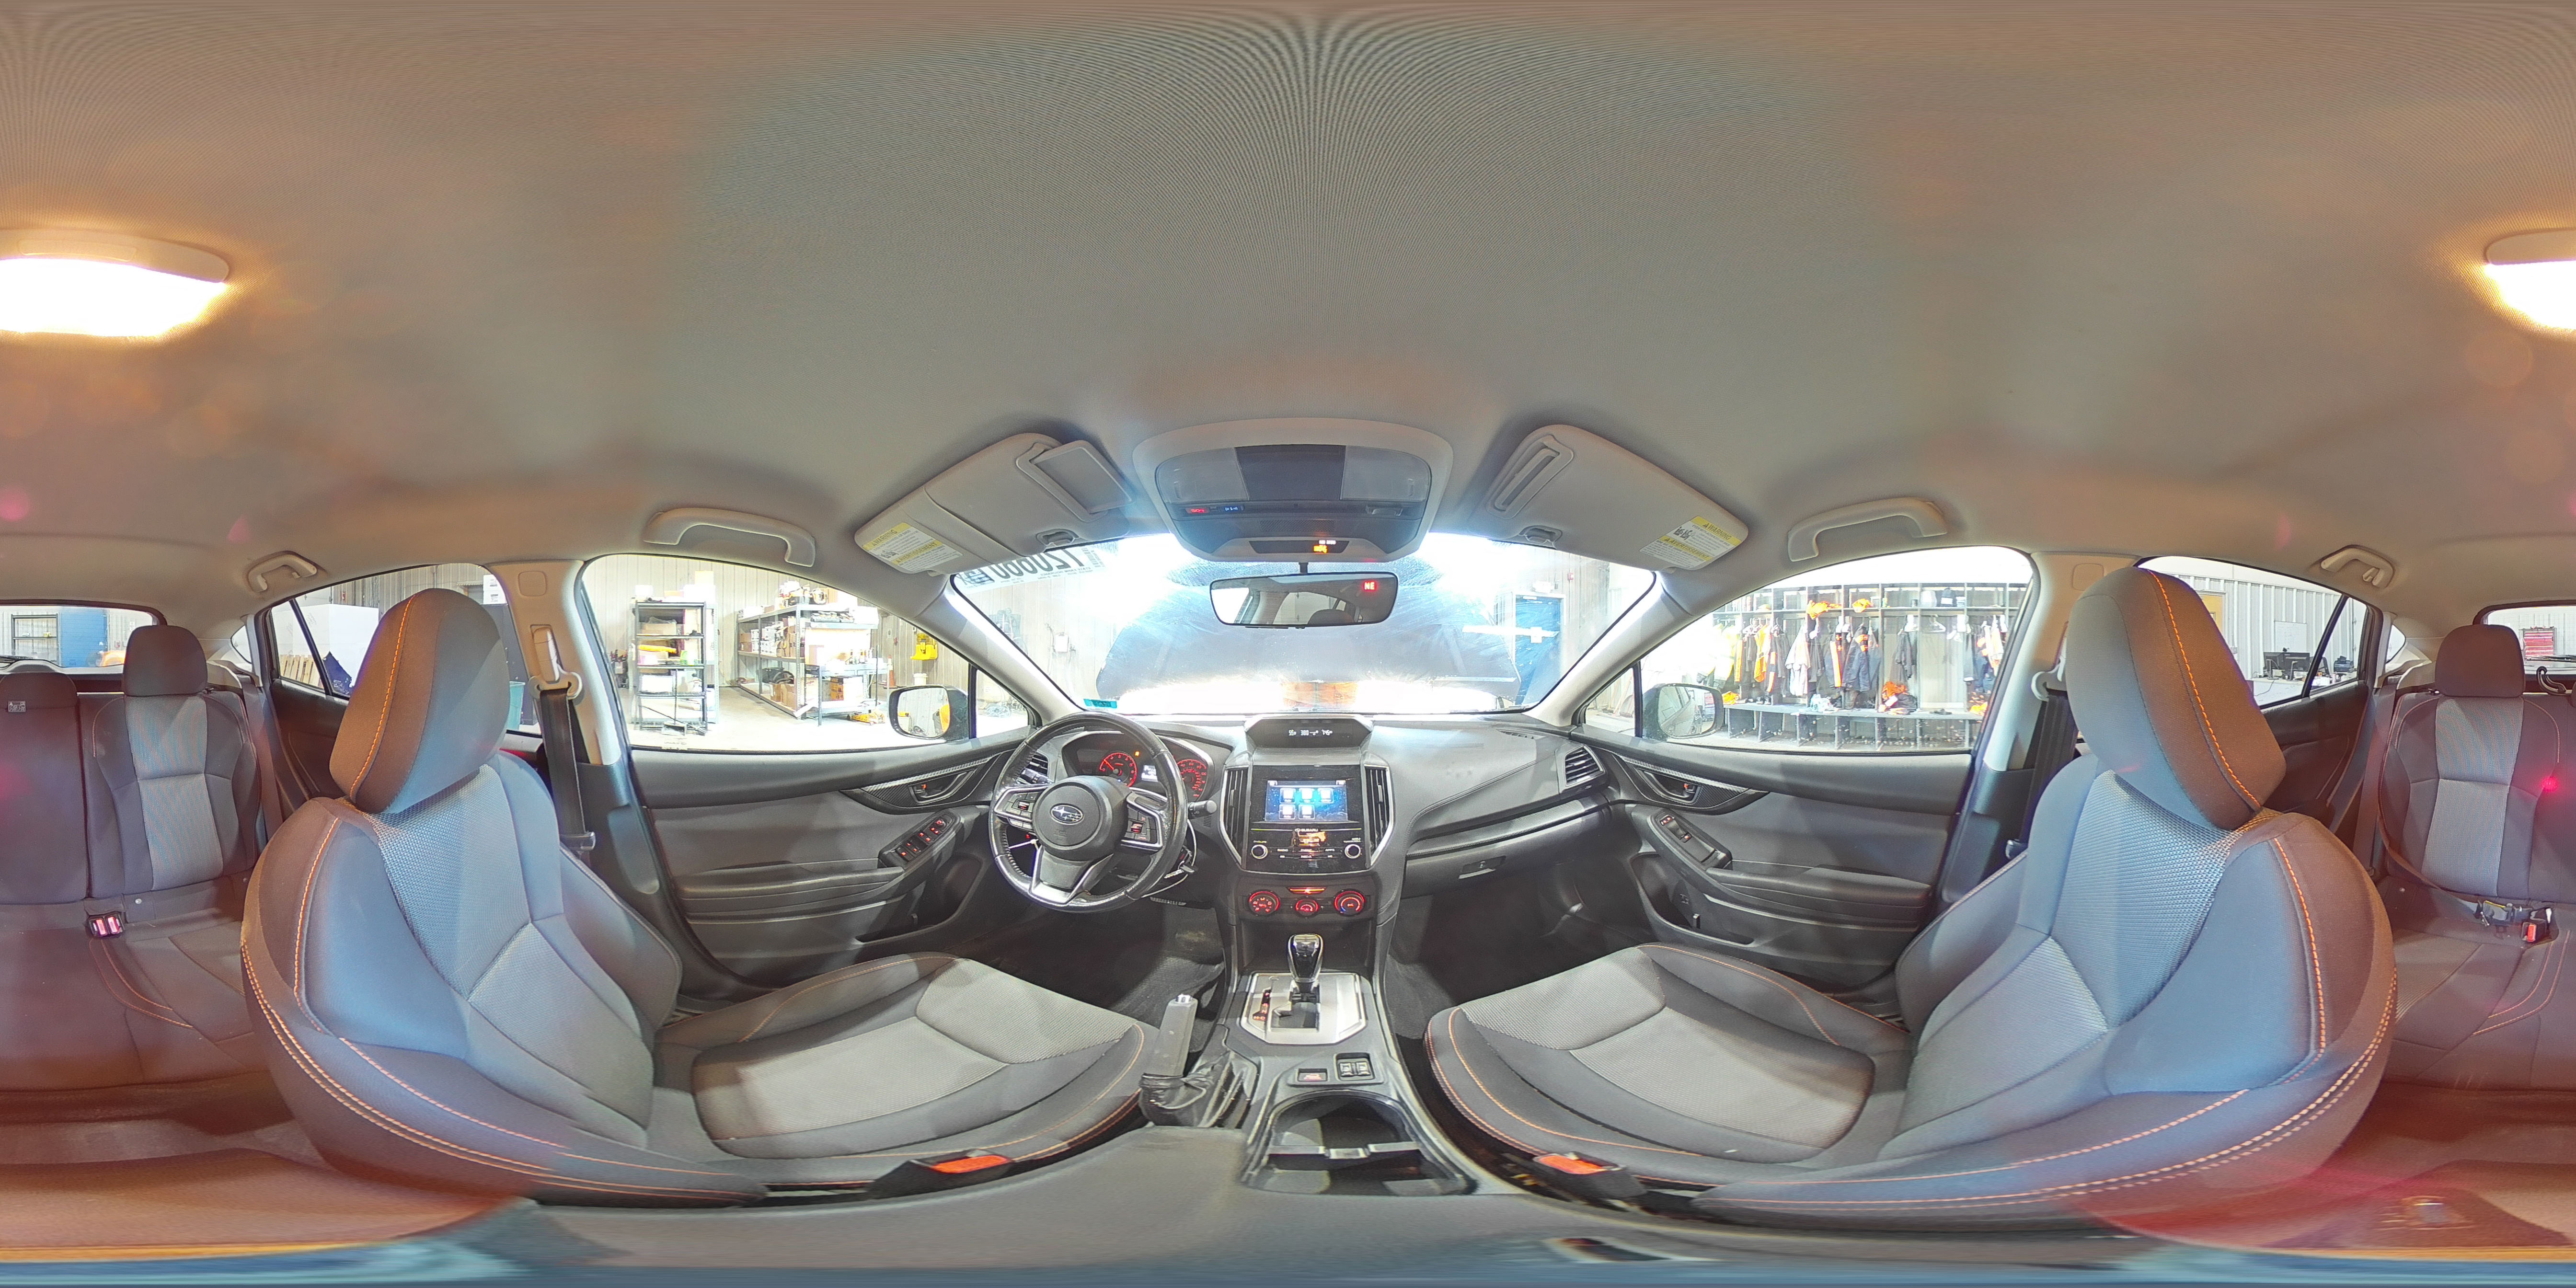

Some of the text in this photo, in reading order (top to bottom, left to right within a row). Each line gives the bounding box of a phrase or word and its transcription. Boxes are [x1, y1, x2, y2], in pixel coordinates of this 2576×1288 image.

[874, 529, 897, 544] WARNING
[1707, 524, 1732, 540] WARNING
[899, 542, 938, 561] AVERTISSEMENT
[1669, 540, 1709, 558] AVERTISSEMENT
[1364, 582, 1375, 590] NE
